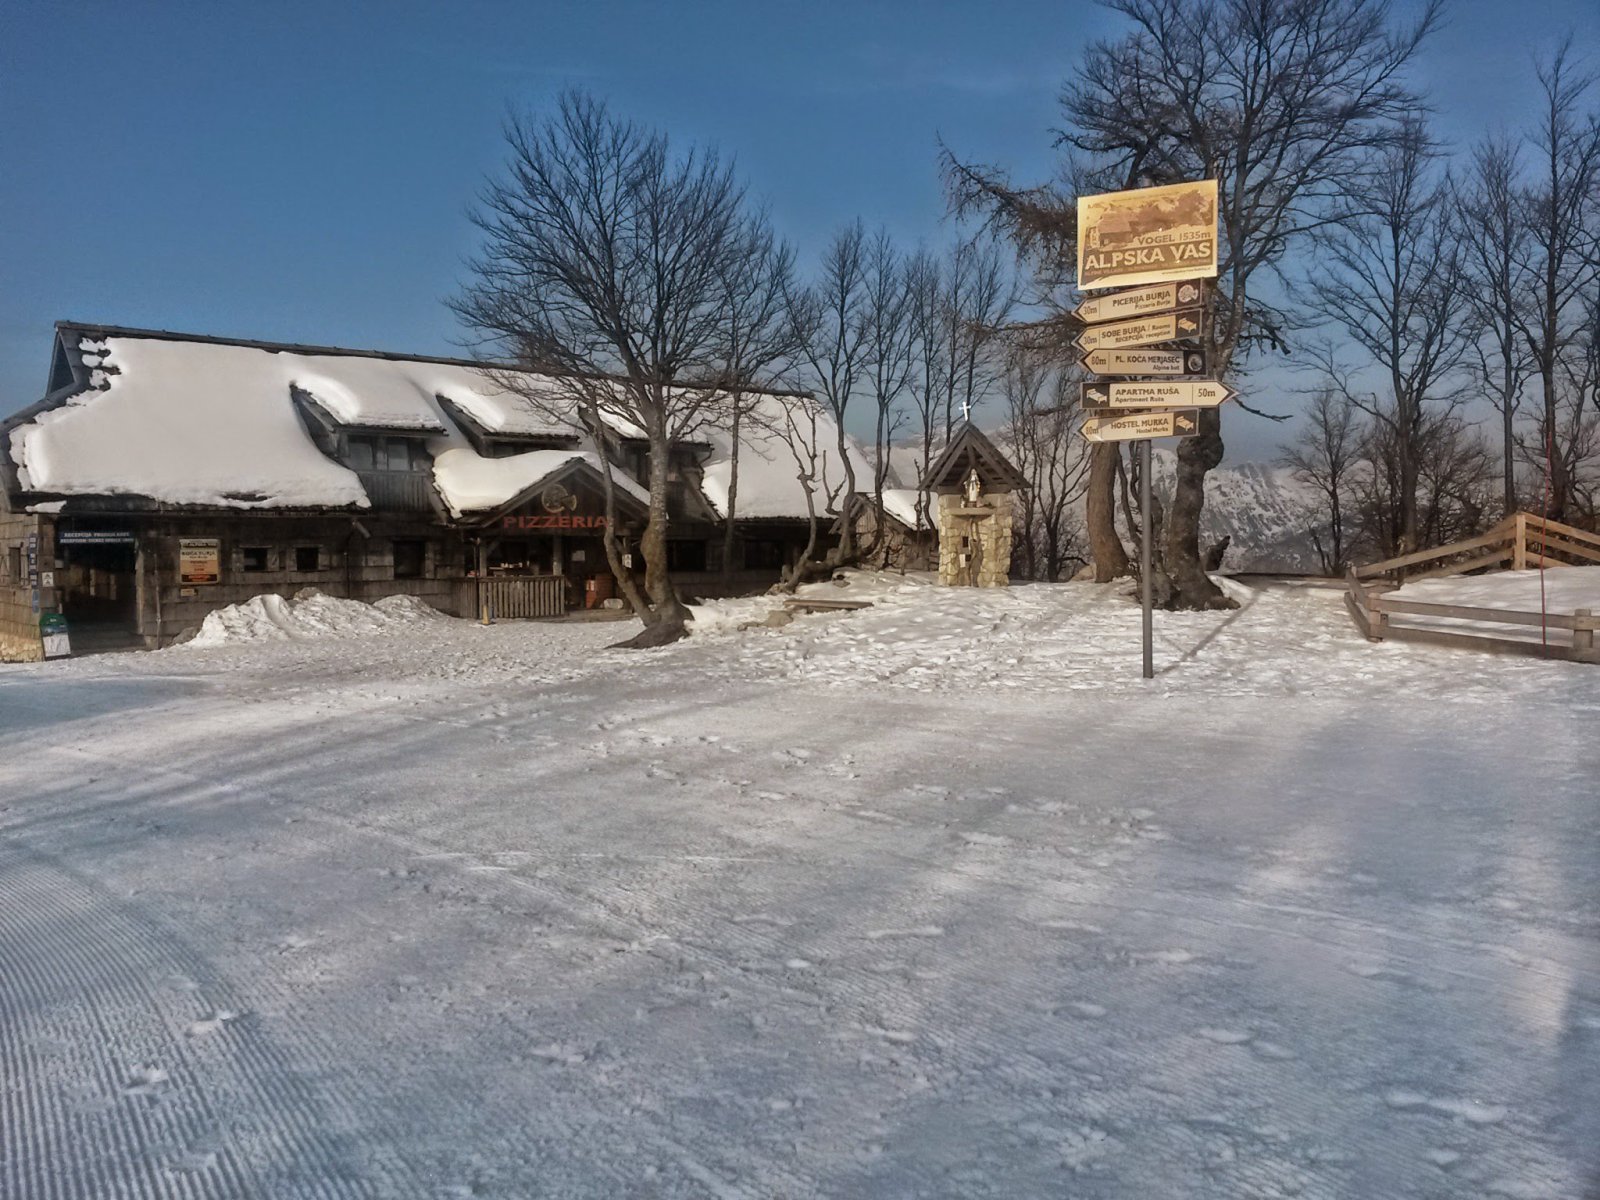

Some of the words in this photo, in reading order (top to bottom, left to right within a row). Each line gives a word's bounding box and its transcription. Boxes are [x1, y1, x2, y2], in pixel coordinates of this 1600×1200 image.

[1138, 234, 1175, 245] VOGEL
[1179, 231, 1211, 242] 1535m
[1085, 249, 1165, 270] ALPSKA
[1171, 242, 1211, 263] VAS
[1113, 295, 1144, 307] PICERIJA
[1146, 291, 1170, 300] BURJA
[1083, 306, 1097, 315] 30m
[1102, 329, 1120, 339] SOBE
[1123, 325, 1146, 335] BURJA
[1083, 336, 1097, 345] 30m
[1157, 386, 1180, 395] RUŠA
[1198, 388, 1216, 398] 50m
[1111, 420, 1139, 430] HOSTEL
[1142, 418, 1169, 426] MURKA
[503, 516, 609, 528] PIZZERIA
